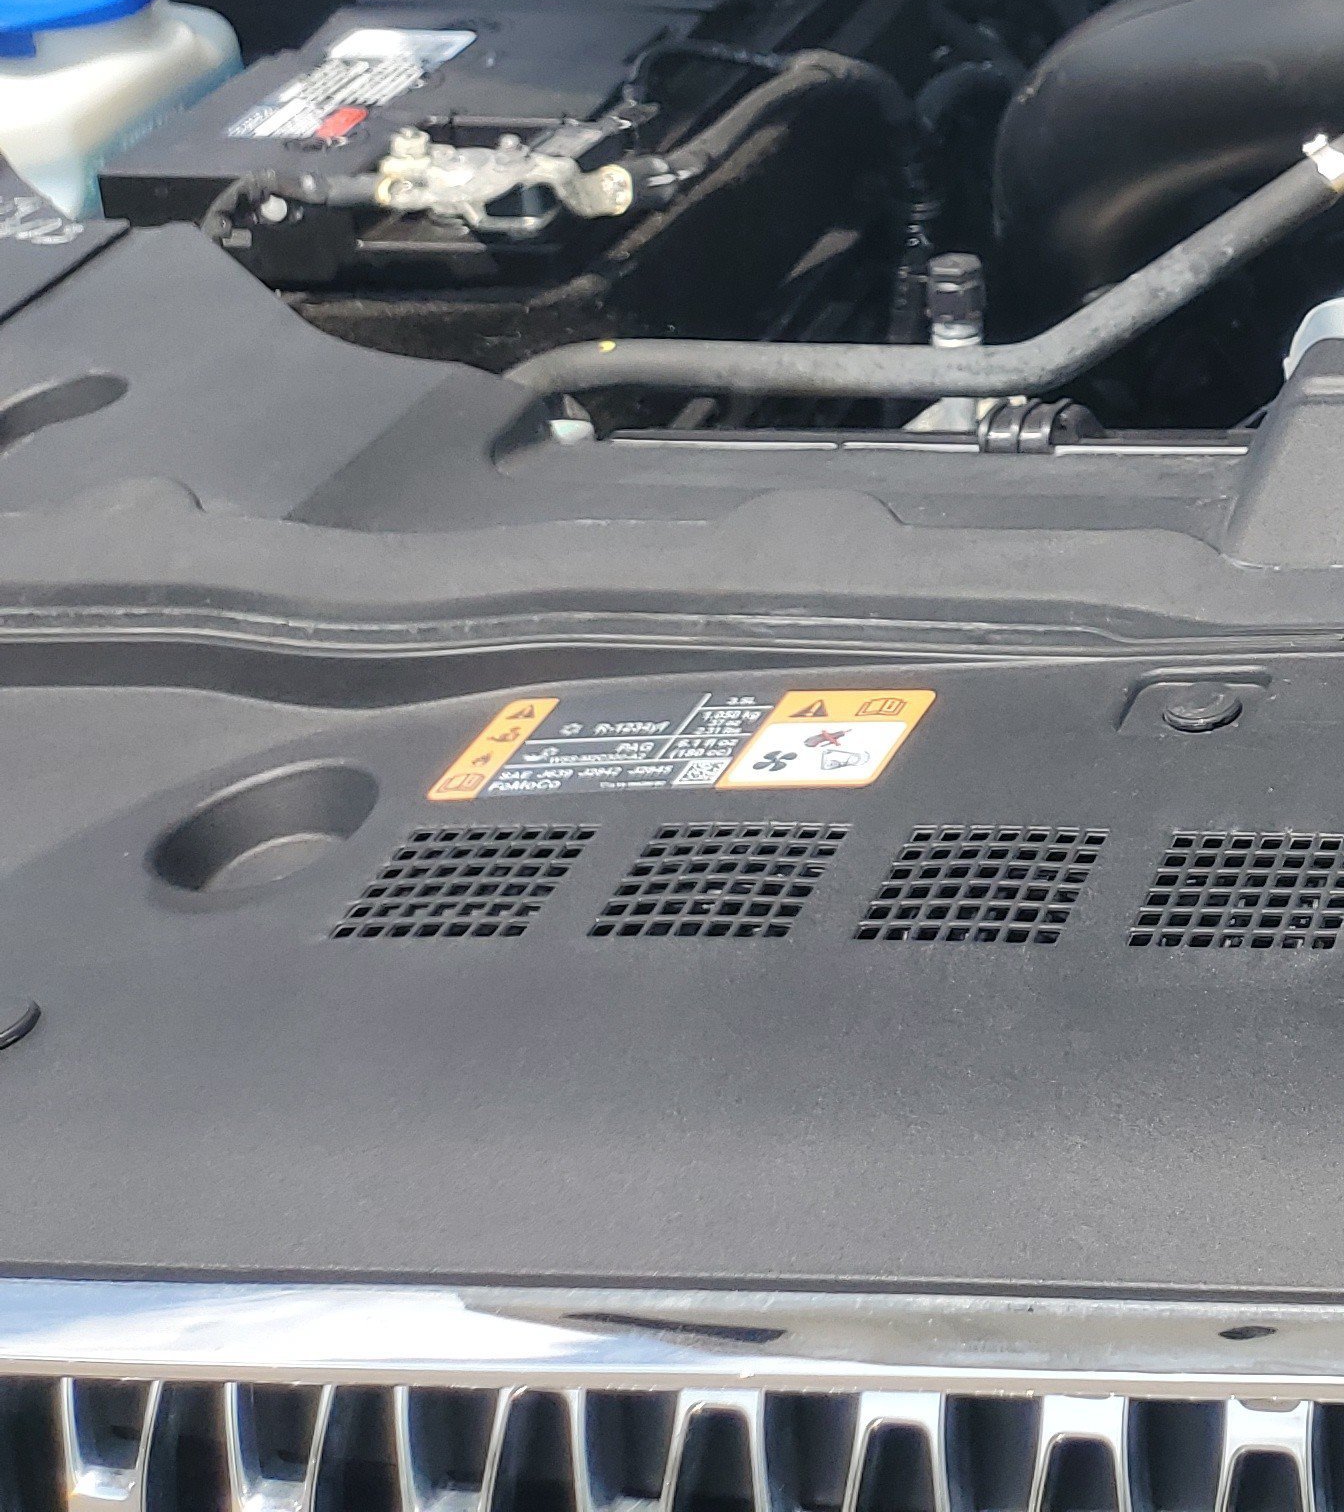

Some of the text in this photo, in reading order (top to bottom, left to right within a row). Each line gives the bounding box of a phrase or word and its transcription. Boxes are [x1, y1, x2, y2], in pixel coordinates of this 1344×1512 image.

[616, 741, 655, 755] PAG
[499, 769, 534, 781] SAE
[487, 778, 563, 794] FoMoCo
